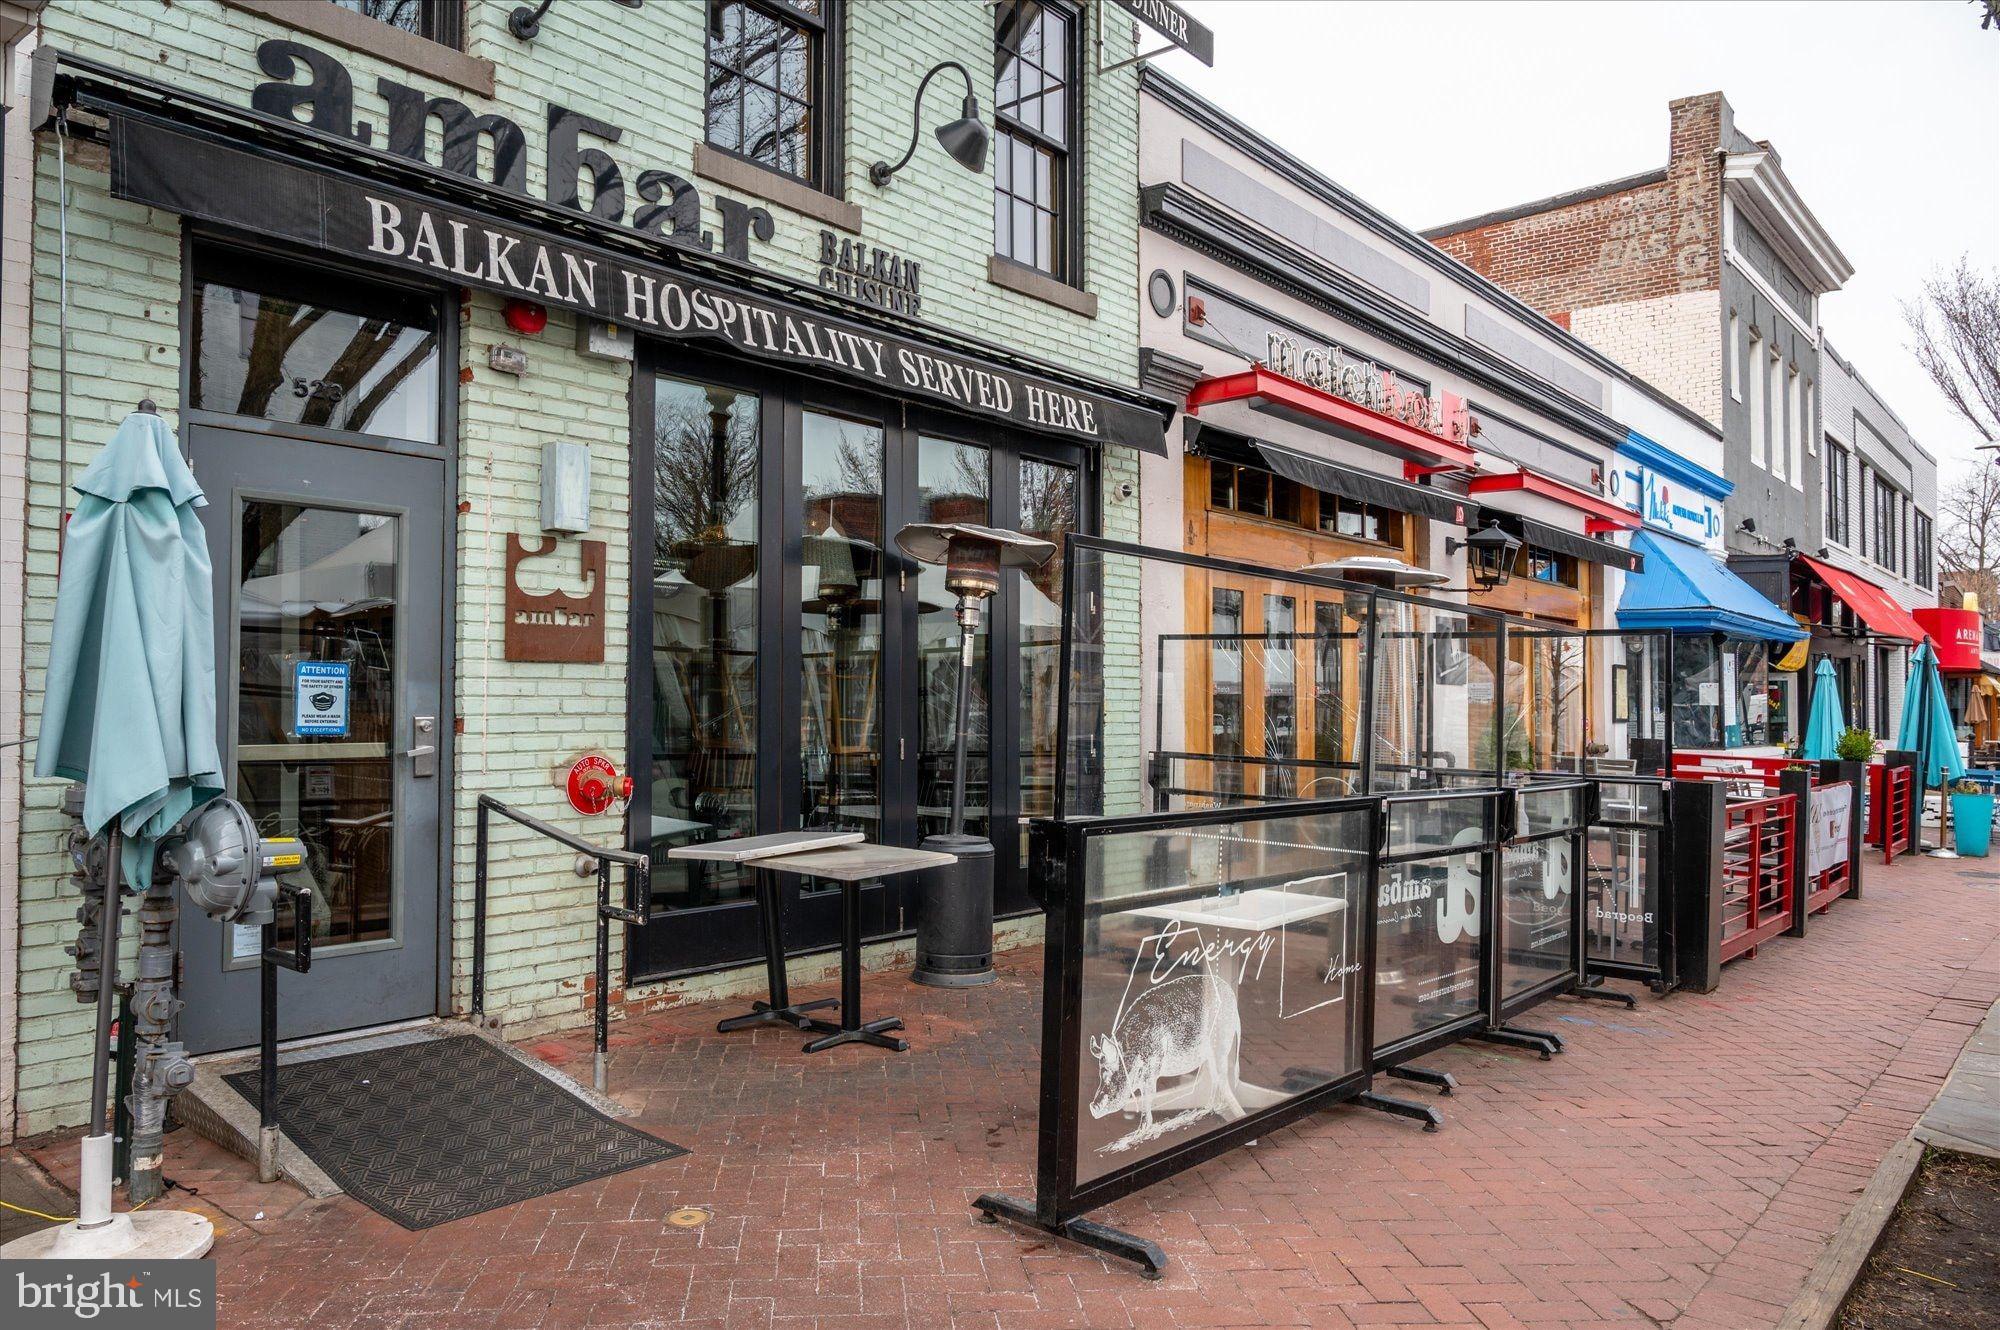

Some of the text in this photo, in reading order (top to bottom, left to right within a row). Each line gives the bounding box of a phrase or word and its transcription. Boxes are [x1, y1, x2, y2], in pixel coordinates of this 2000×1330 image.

[819, 229, 921, 294] BALKAN
[365, 196, 1098, 436] BALKAN HOSPITALITY SERVED HERE
[294, 376, 343, 402] 523
[301, 666, 345, 675] ATTENTION
[573, 759, 590, 774] AUTO
[593, 757, 611, 770] SPKR
[1151, 919, 1363, 985] Energy Home
